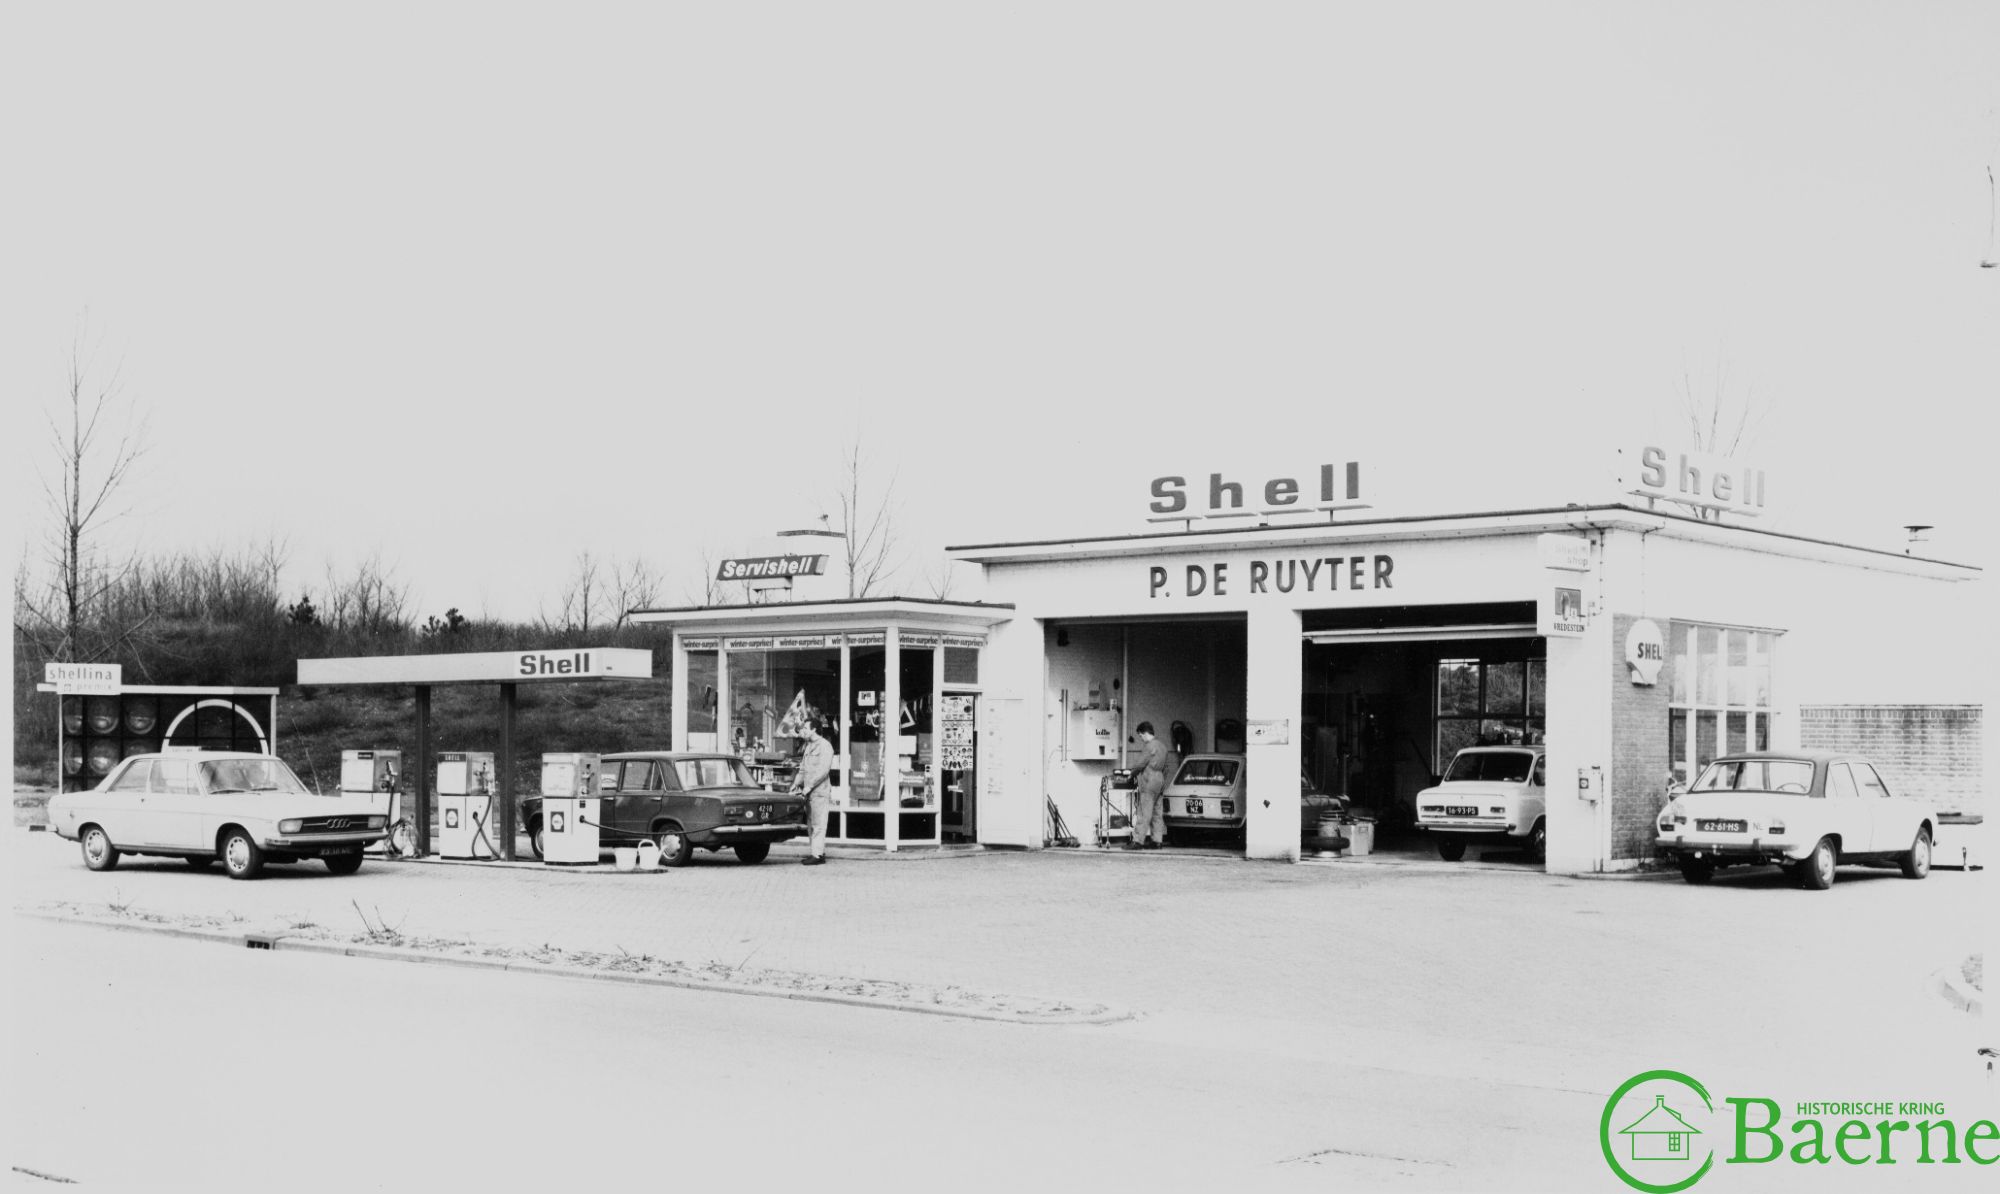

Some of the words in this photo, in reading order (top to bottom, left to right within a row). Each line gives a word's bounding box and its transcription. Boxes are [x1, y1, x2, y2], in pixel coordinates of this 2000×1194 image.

[1641, 446, 1766, 508] Shell
[1149, 461, 1360, 514] Shell
[722, 556, 813, 578] Servishell
[1149, 565, 1171, 599] P.
[1186, 562, 1229, 597] DE
[1250, 554, 1395, 594] RUYTER
[730, 639, 772, 649] winter-surprises
[779, 638, 823, 648] winter-surprises
[942, 637, 984, 649] winter-surprises
[1637, 642, 1663, 660] SHEL
[519, 652, 590, 675] Shell
[49, 667, 112, 681] shellina
[1703, 821, 1740, 832] 62-61-HS
[1753, 821, 1765, 831] NL
